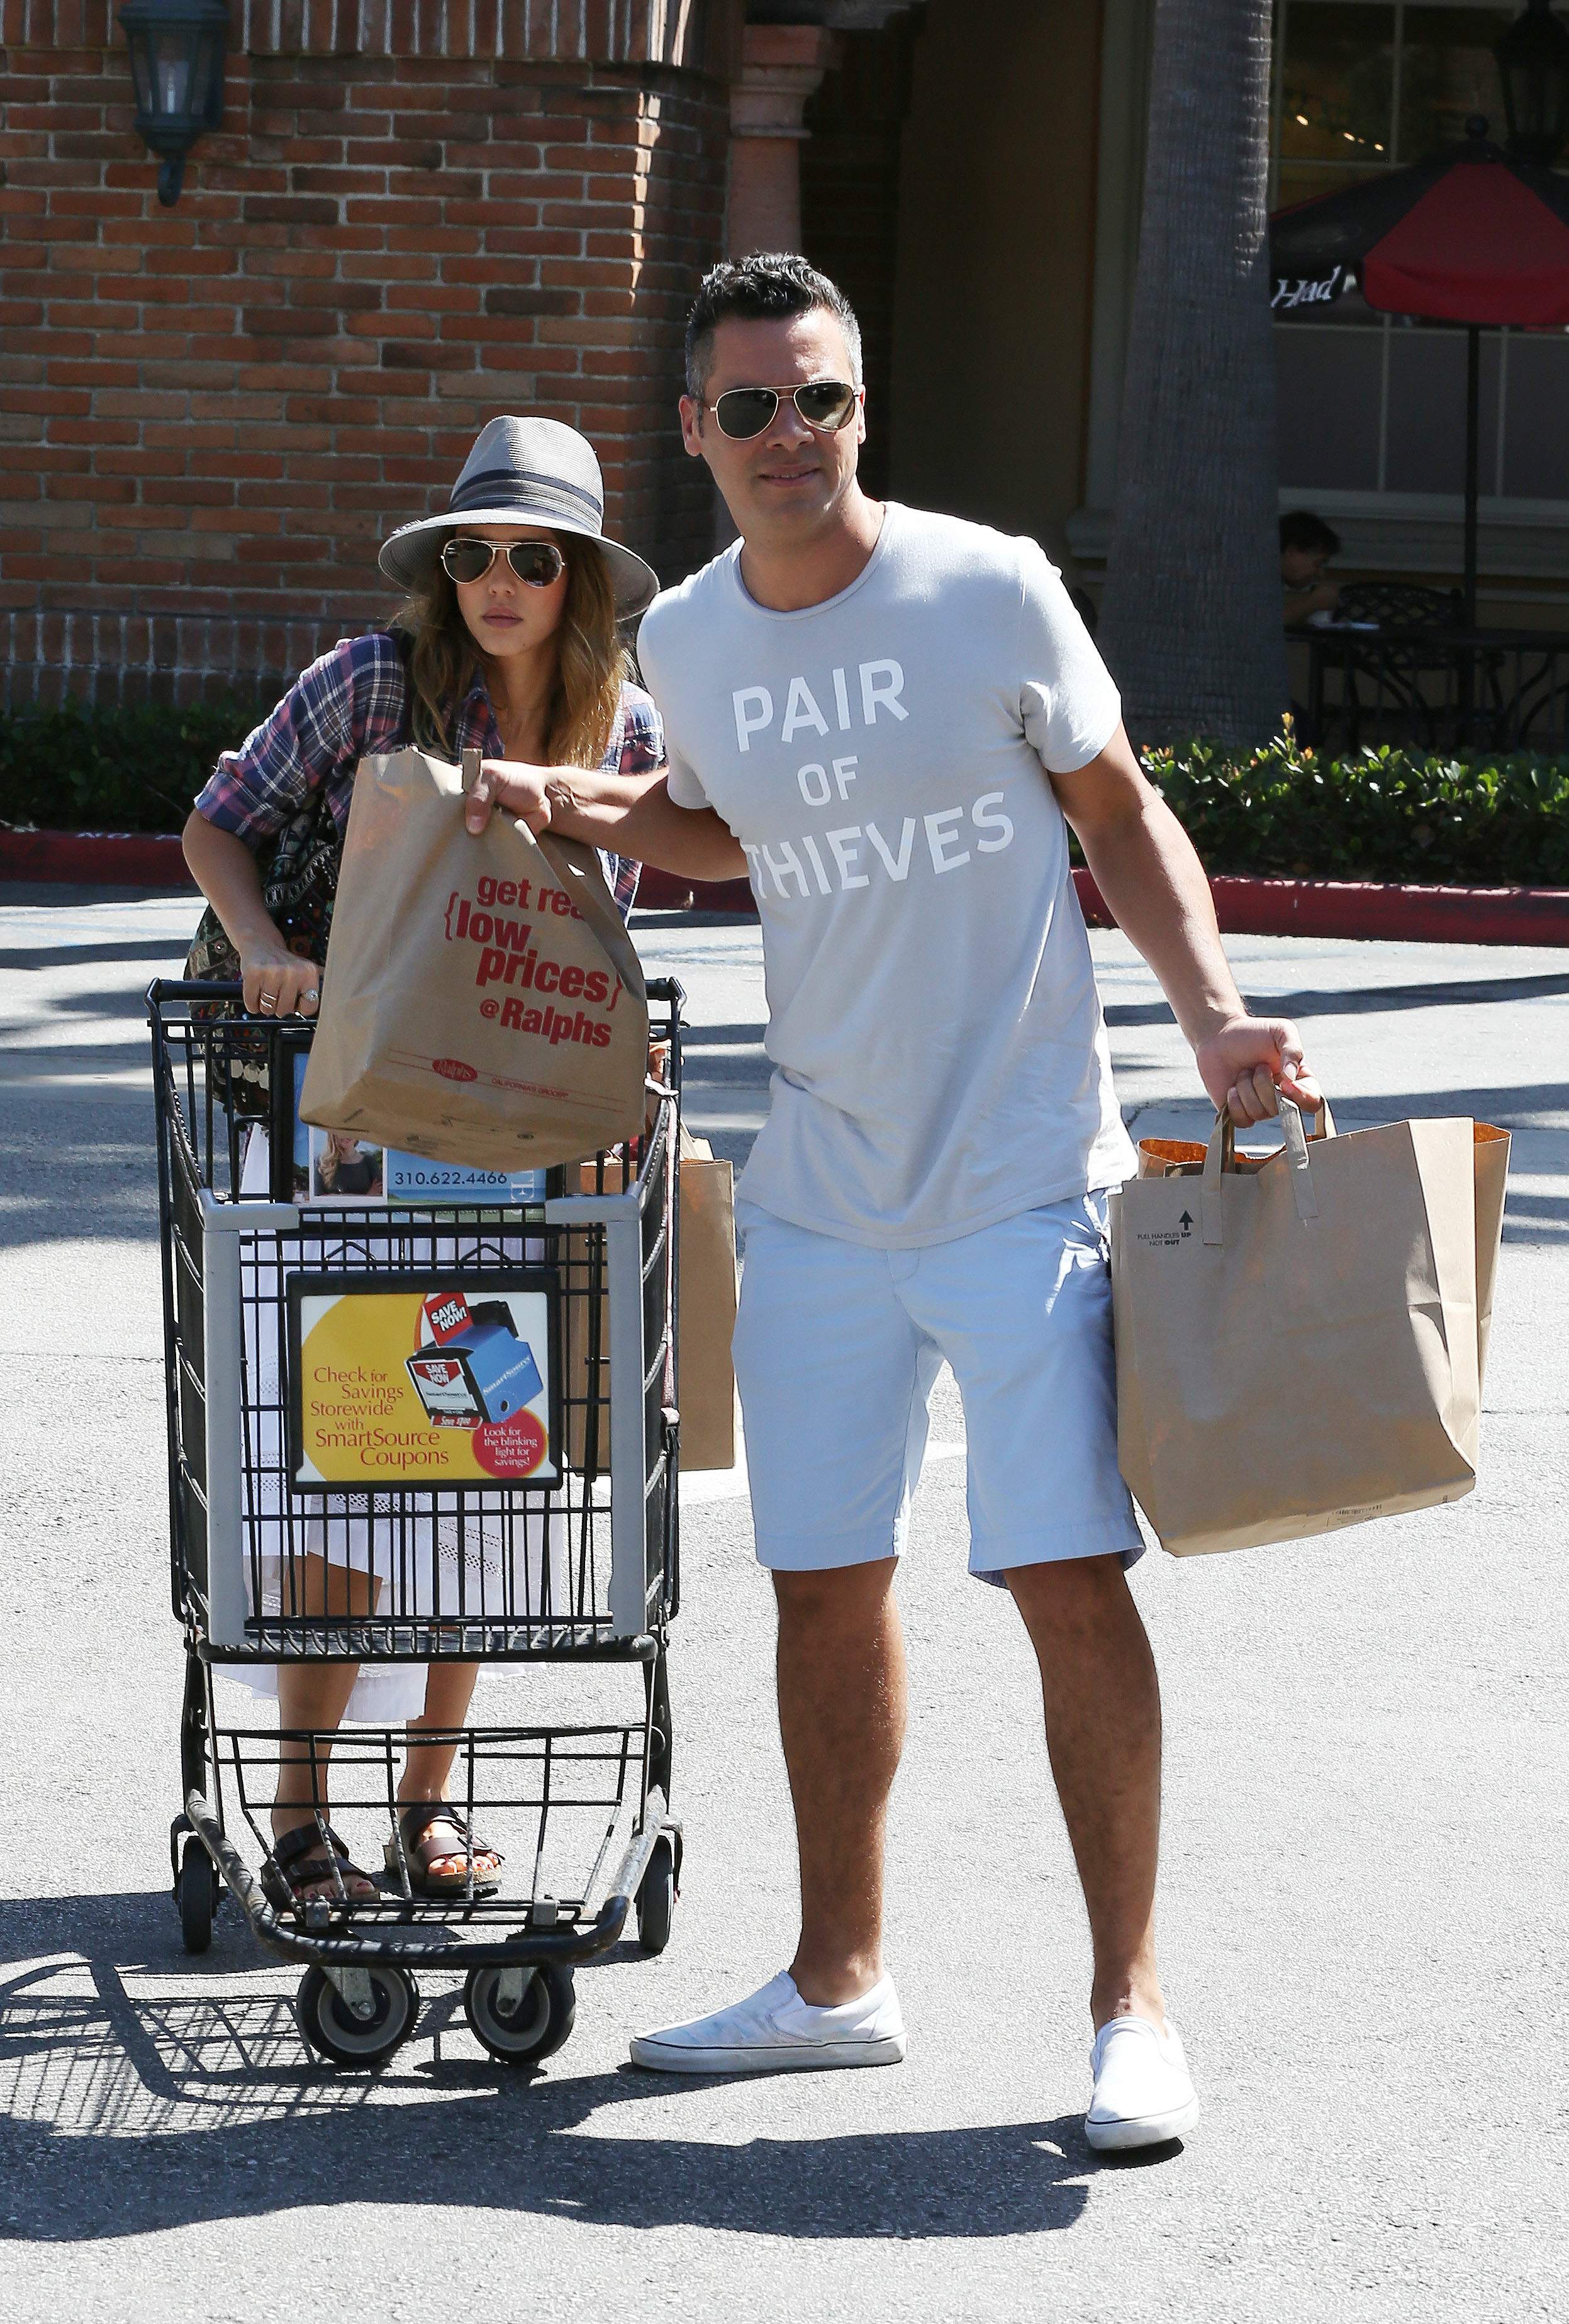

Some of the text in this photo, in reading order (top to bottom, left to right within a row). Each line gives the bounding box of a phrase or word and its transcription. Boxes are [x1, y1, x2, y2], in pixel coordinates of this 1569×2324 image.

[732, 658, 910, 752] PAIR
[796, 756, 859, 807] OF
[741, 791, 1015, 900] THIEVES
[476, 876, 532, 910] get
[479, 997, 612, 1047] @Ralphs
[394, 1171, 508, 1185] 310.622.4466
[431, 1300, 457, 1325] SAVE
[440, 1306, 468, 1332] NOW!
[314, 1366, 388, 1383] Check for
[425, 1363, 449, 1373] SAVE
[341, 1383, 405, 1404] Savings
[311, 1399, 394, 1417] Storewide
[335, 1417, 364, 1431] with
[484, 1426, 522, 1436] Look for
[315, 1428, 441, 1448] SmartSource
[484, 1436, 538, 1448] the blinking
[360, 1446, 450, 1471] Coupons
[494, 1446, 530, 1459] light for
[494, 1456, 530, 1468] savings!
